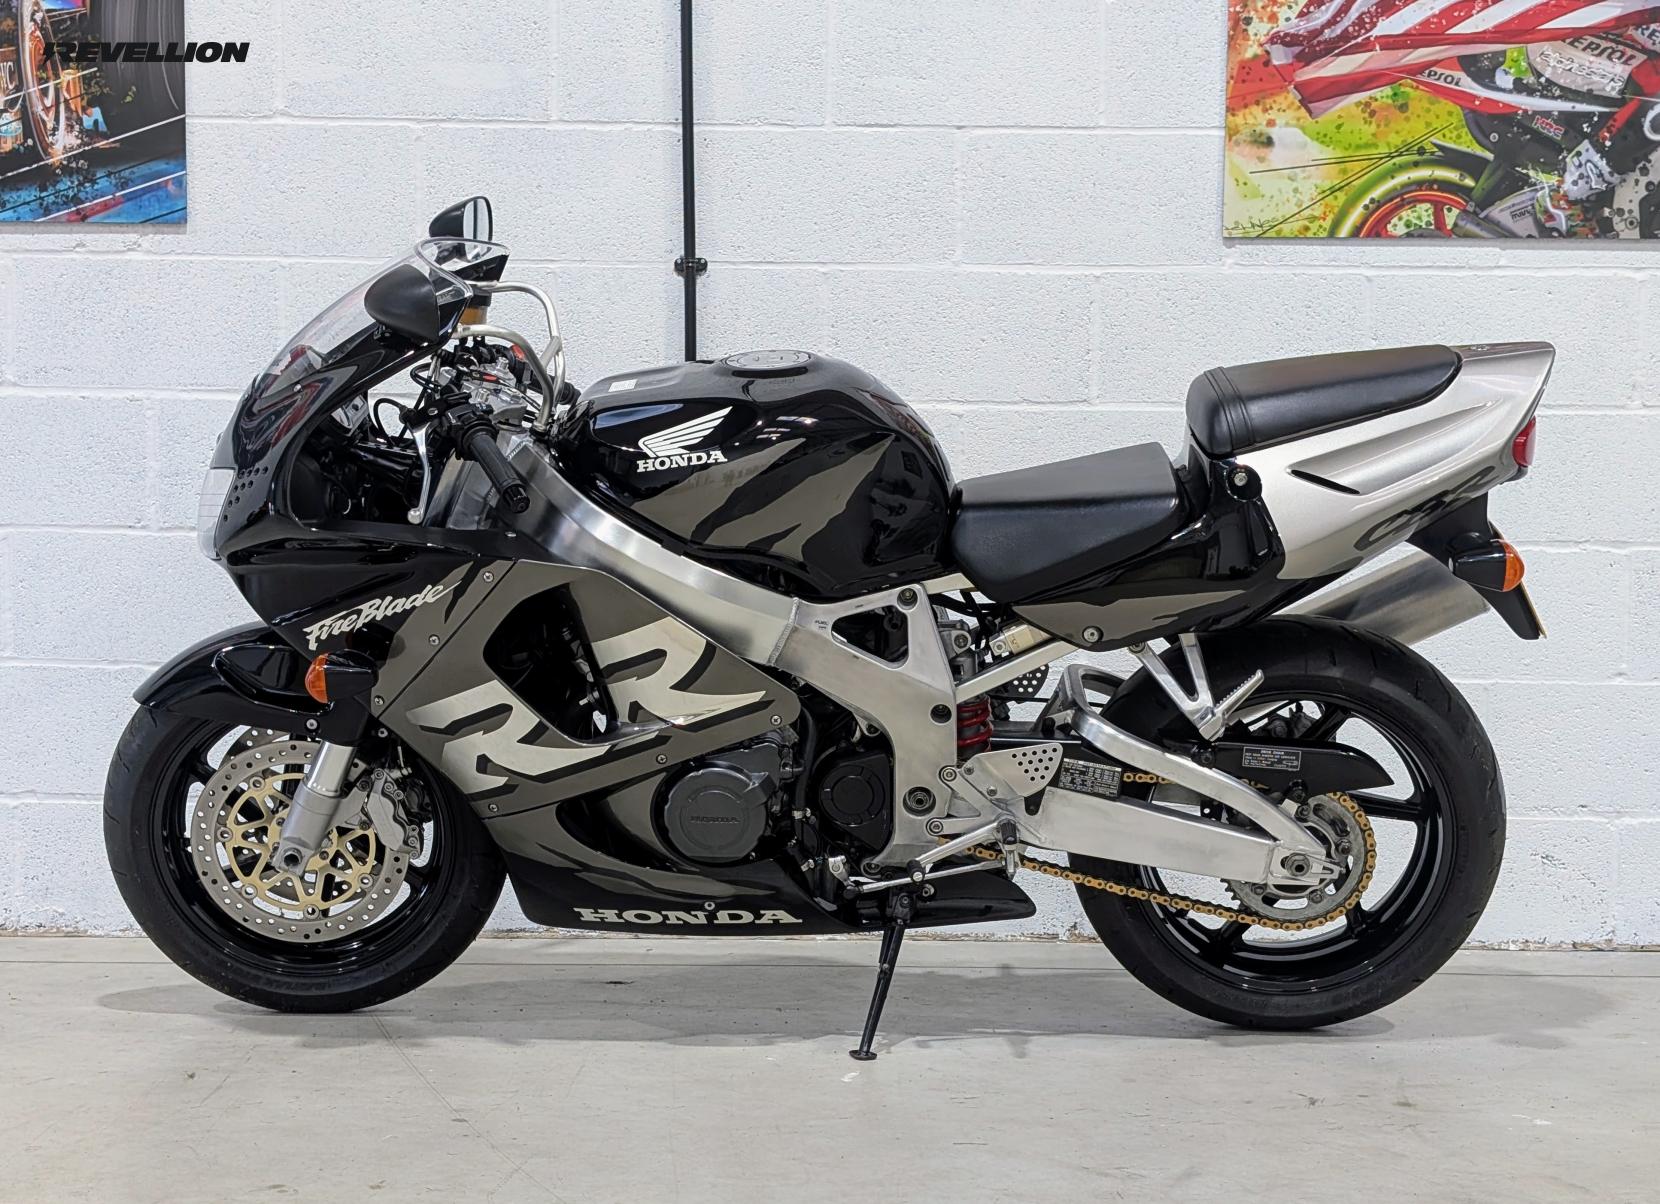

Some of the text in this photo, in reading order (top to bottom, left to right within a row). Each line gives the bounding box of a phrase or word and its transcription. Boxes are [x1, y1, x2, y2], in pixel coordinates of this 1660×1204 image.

[1561, 35, 1637, 67] EPSOL
[636, 451, 728, 473] HONDA
[302, 580, 462, 651] FireBlade
[573, 907, 803, 925] HONDA
